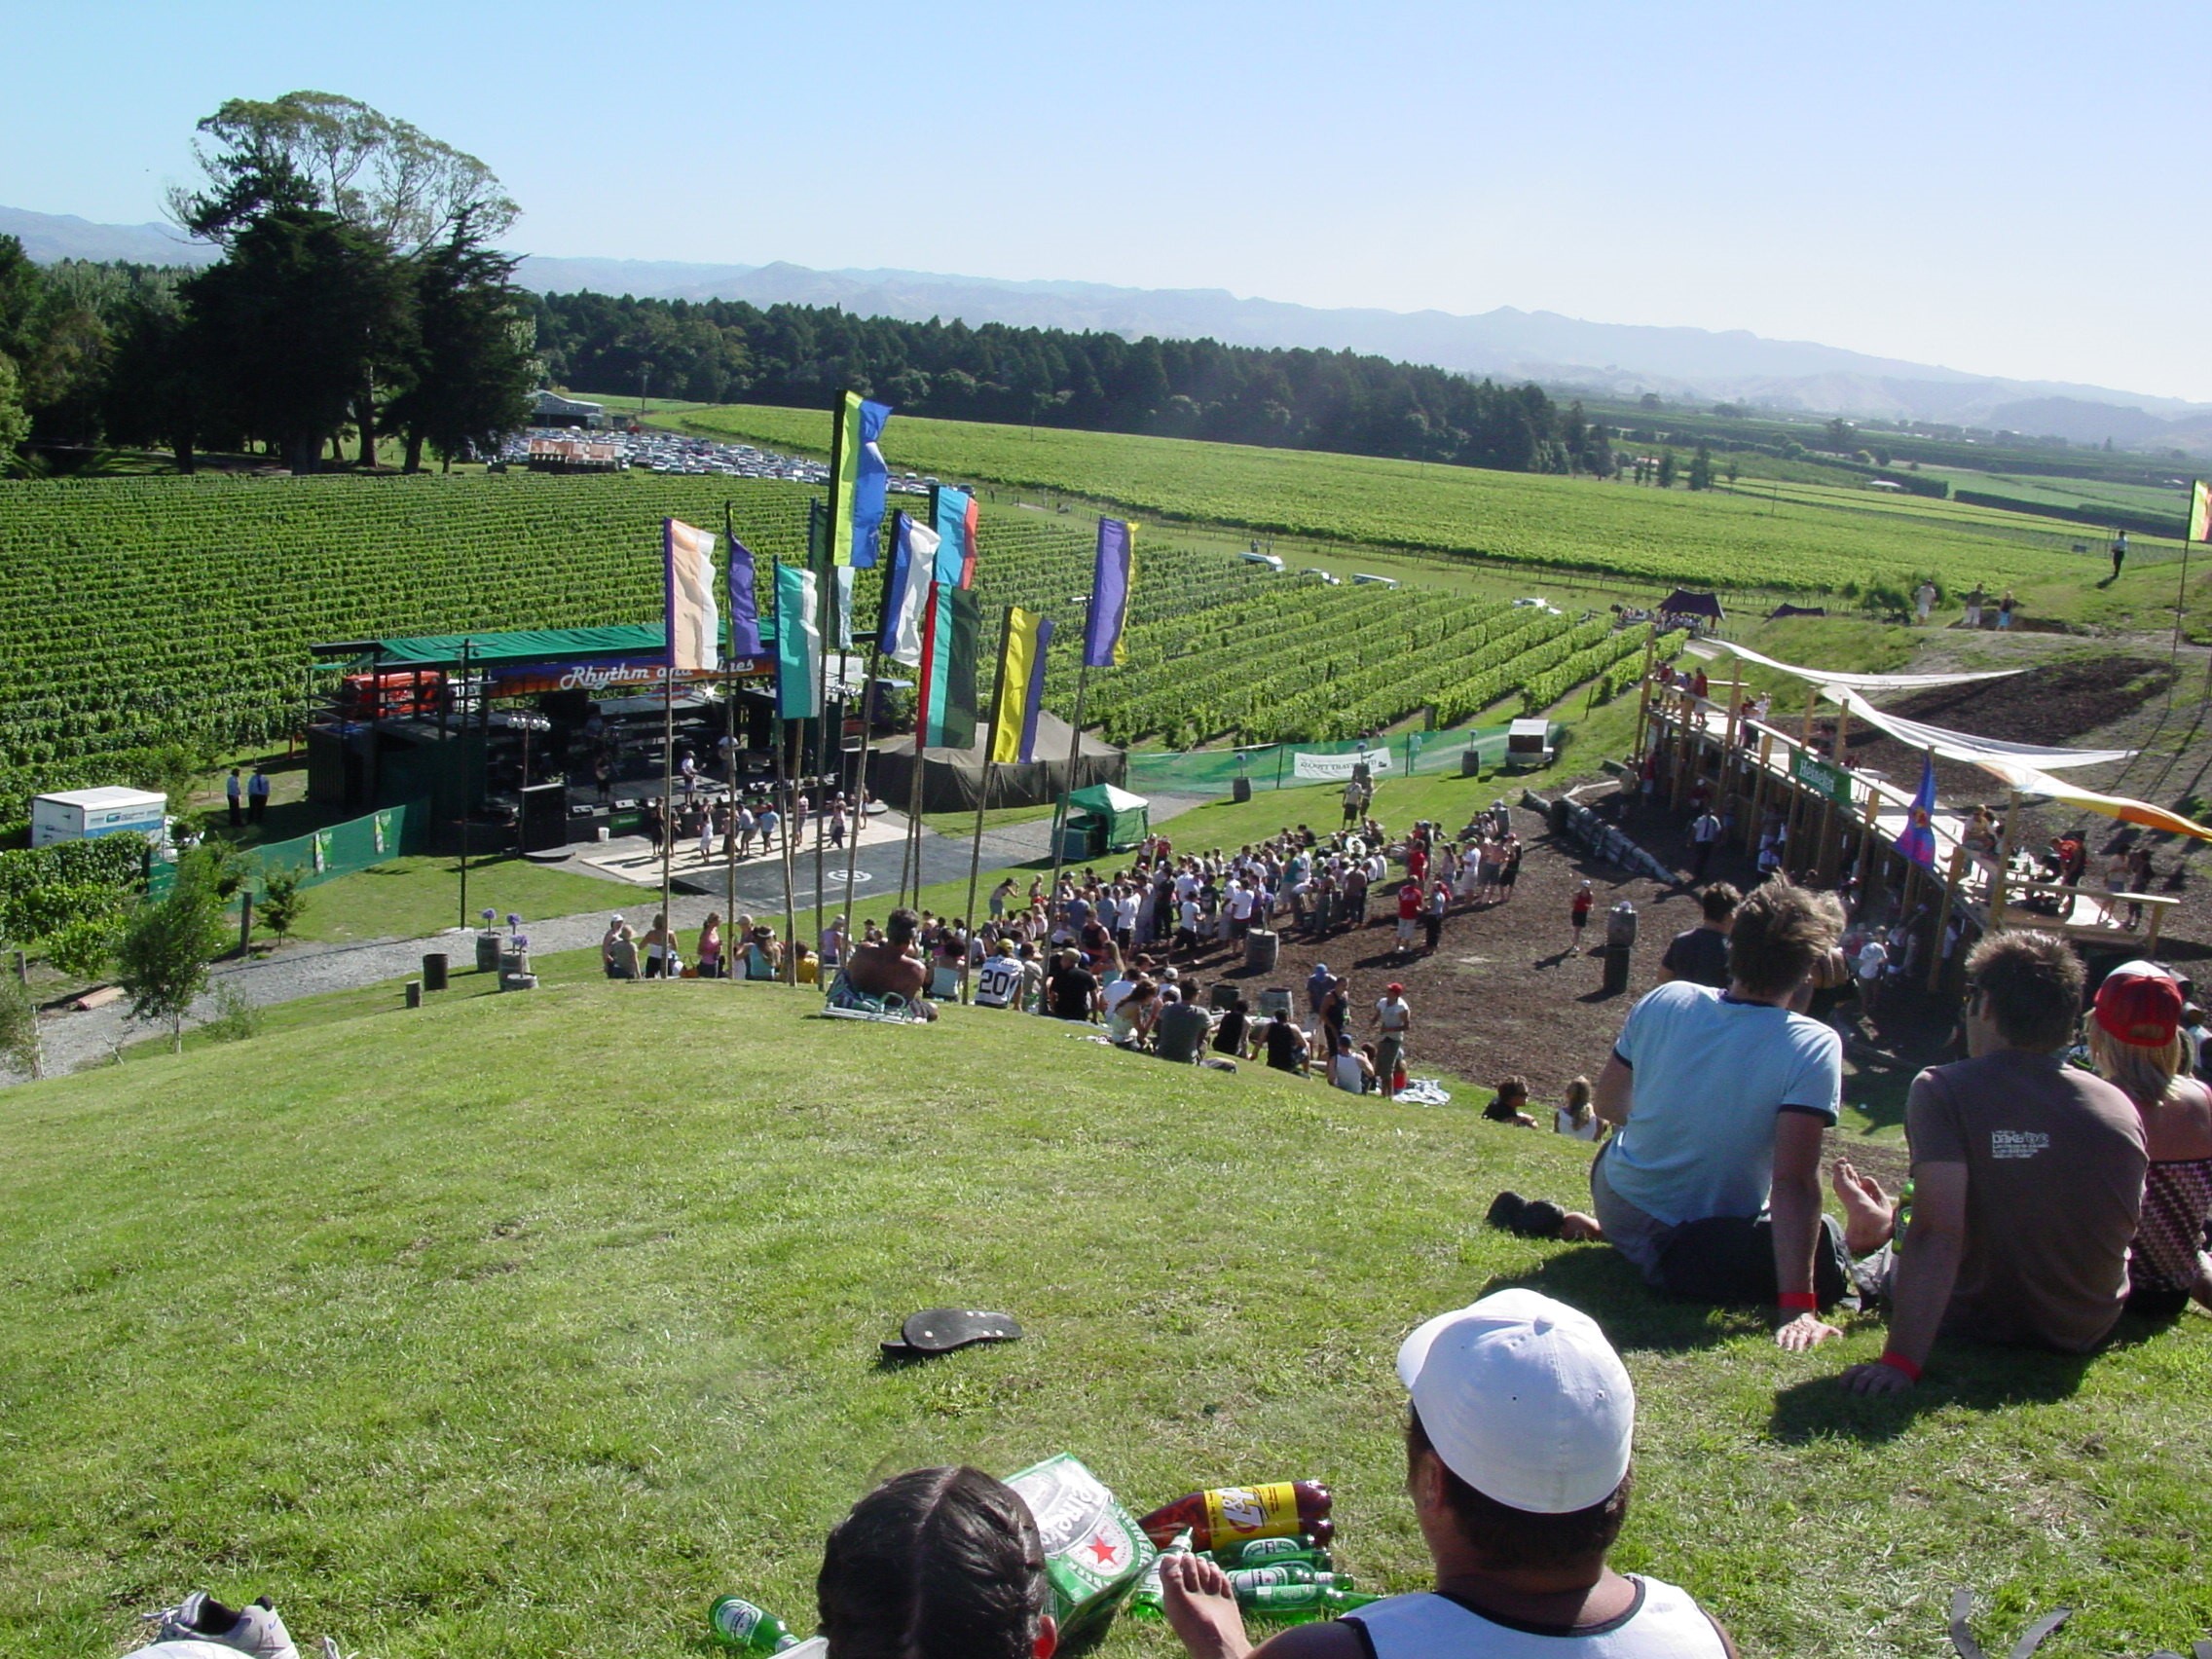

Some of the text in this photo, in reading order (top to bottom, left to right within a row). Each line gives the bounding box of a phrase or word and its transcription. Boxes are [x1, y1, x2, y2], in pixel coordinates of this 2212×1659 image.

[560, 663, 650, 690] Rhythm
[978, 969, 1010, 996] 20
[1216, 1487, 1265, 1528] L&P
